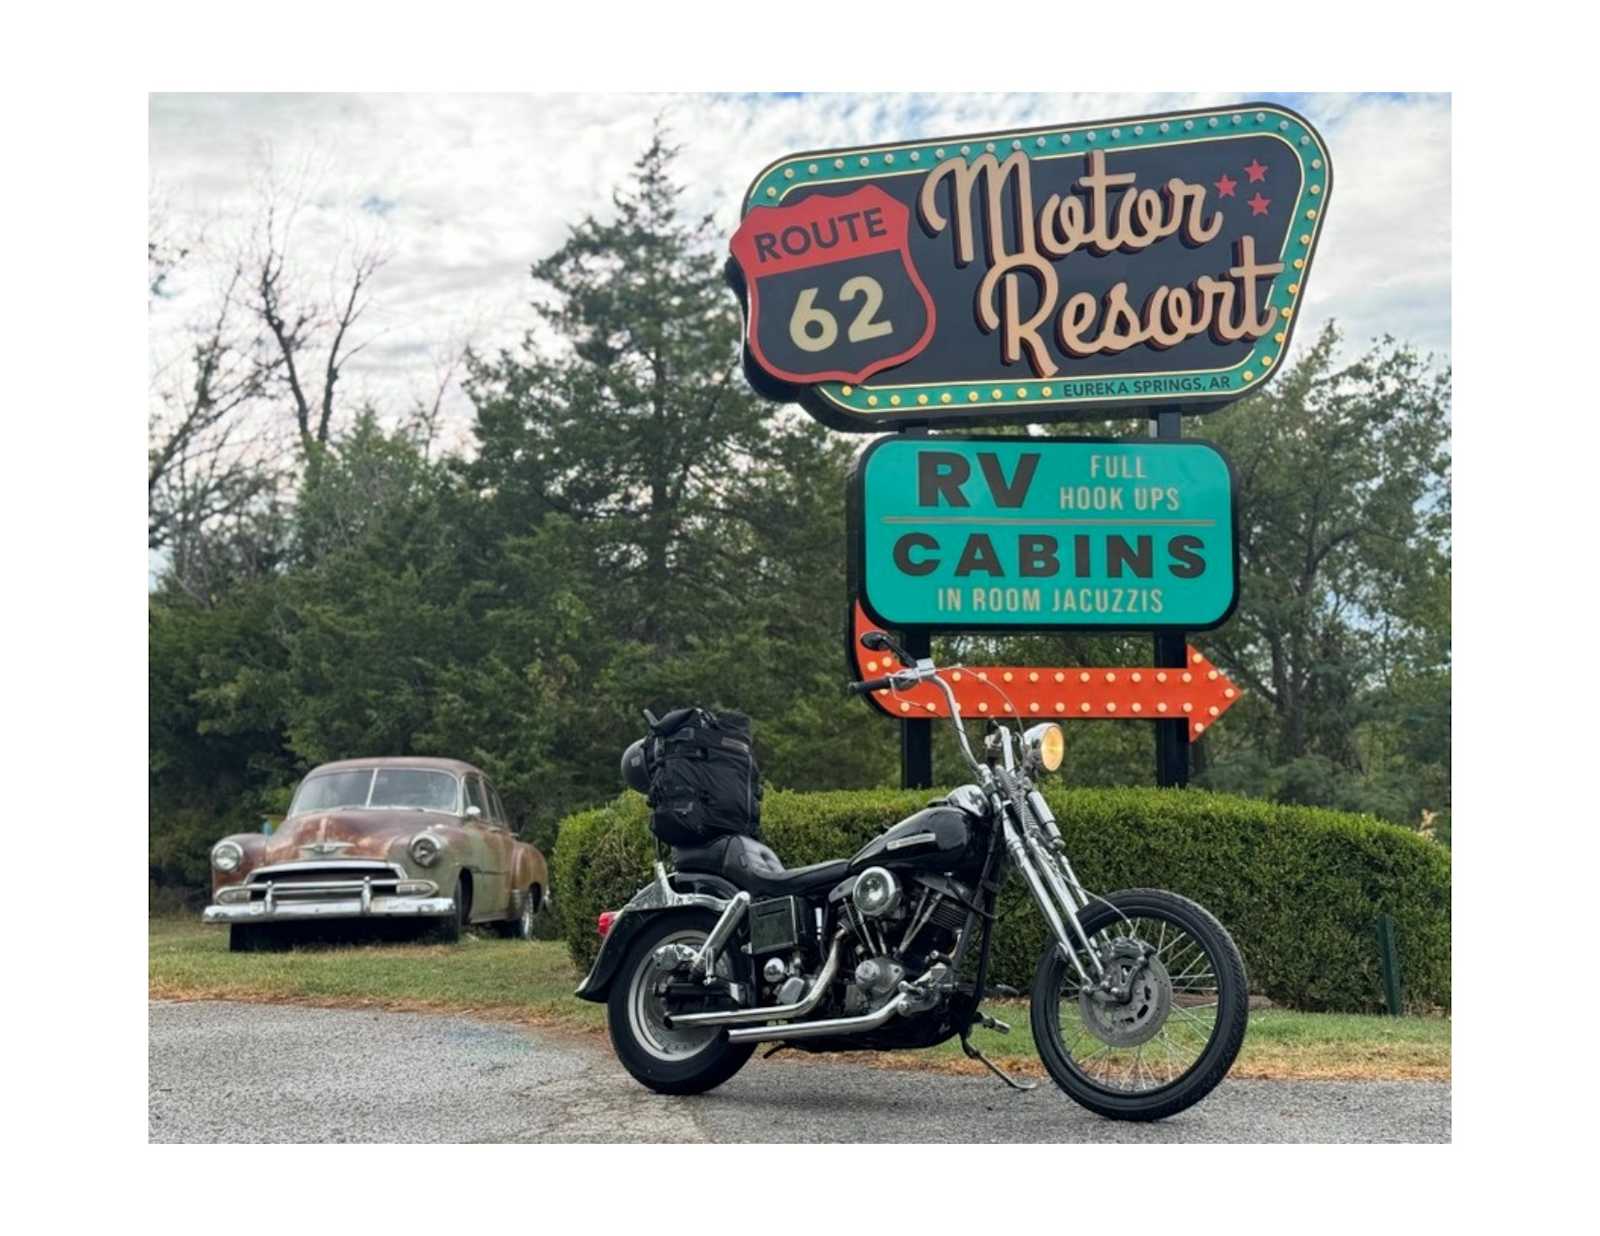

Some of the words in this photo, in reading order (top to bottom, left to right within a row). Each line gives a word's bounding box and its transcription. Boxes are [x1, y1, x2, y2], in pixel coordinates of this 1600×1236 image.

[920, 150, 1223, 263] Motor
[753, 207, 888, 263] ROUTE
[789, 275, 893, 352] 62
[979, 235, 1285, 378] Resort
[1064, 381, 1129, 397] EUREKA
[1134, 377, 1207, 393] SPRINGS,
[1209, 375, 1231, 389] AR
[917, 450, 1041, 509] RV
[1090, 455, 1147, 480] FULL
[1059, 486, 1124, 511] HOOK
[1135, 487, 1180, 511] UPS
[892, 531, 1207, 579] CABINS
[937, 587, 962, 612] IN
[972, 587, 1041, 612] ROOM
[1051, 588, 1165, 613] JACUZZIS
